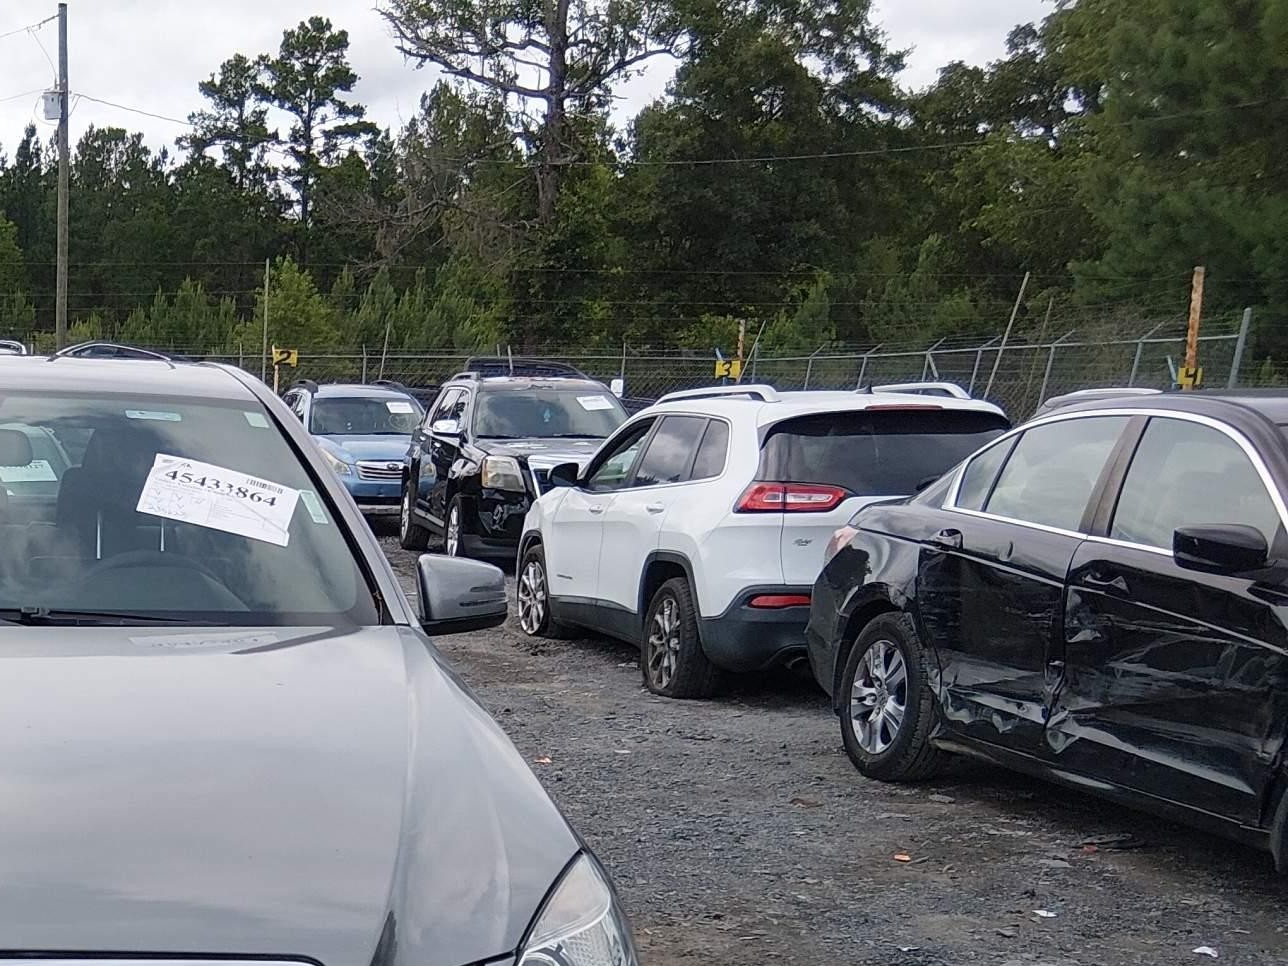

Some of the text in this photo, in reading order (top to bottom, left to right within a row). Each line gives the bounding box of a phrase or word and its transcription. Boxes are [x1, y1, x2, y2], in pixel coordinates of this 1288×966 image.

[274, 350, 292, 366] 2
[718, 361, 732, 379] 3
[1184, 368, 1199, 385] 4
[164, 469, 277, 507] 45433864
